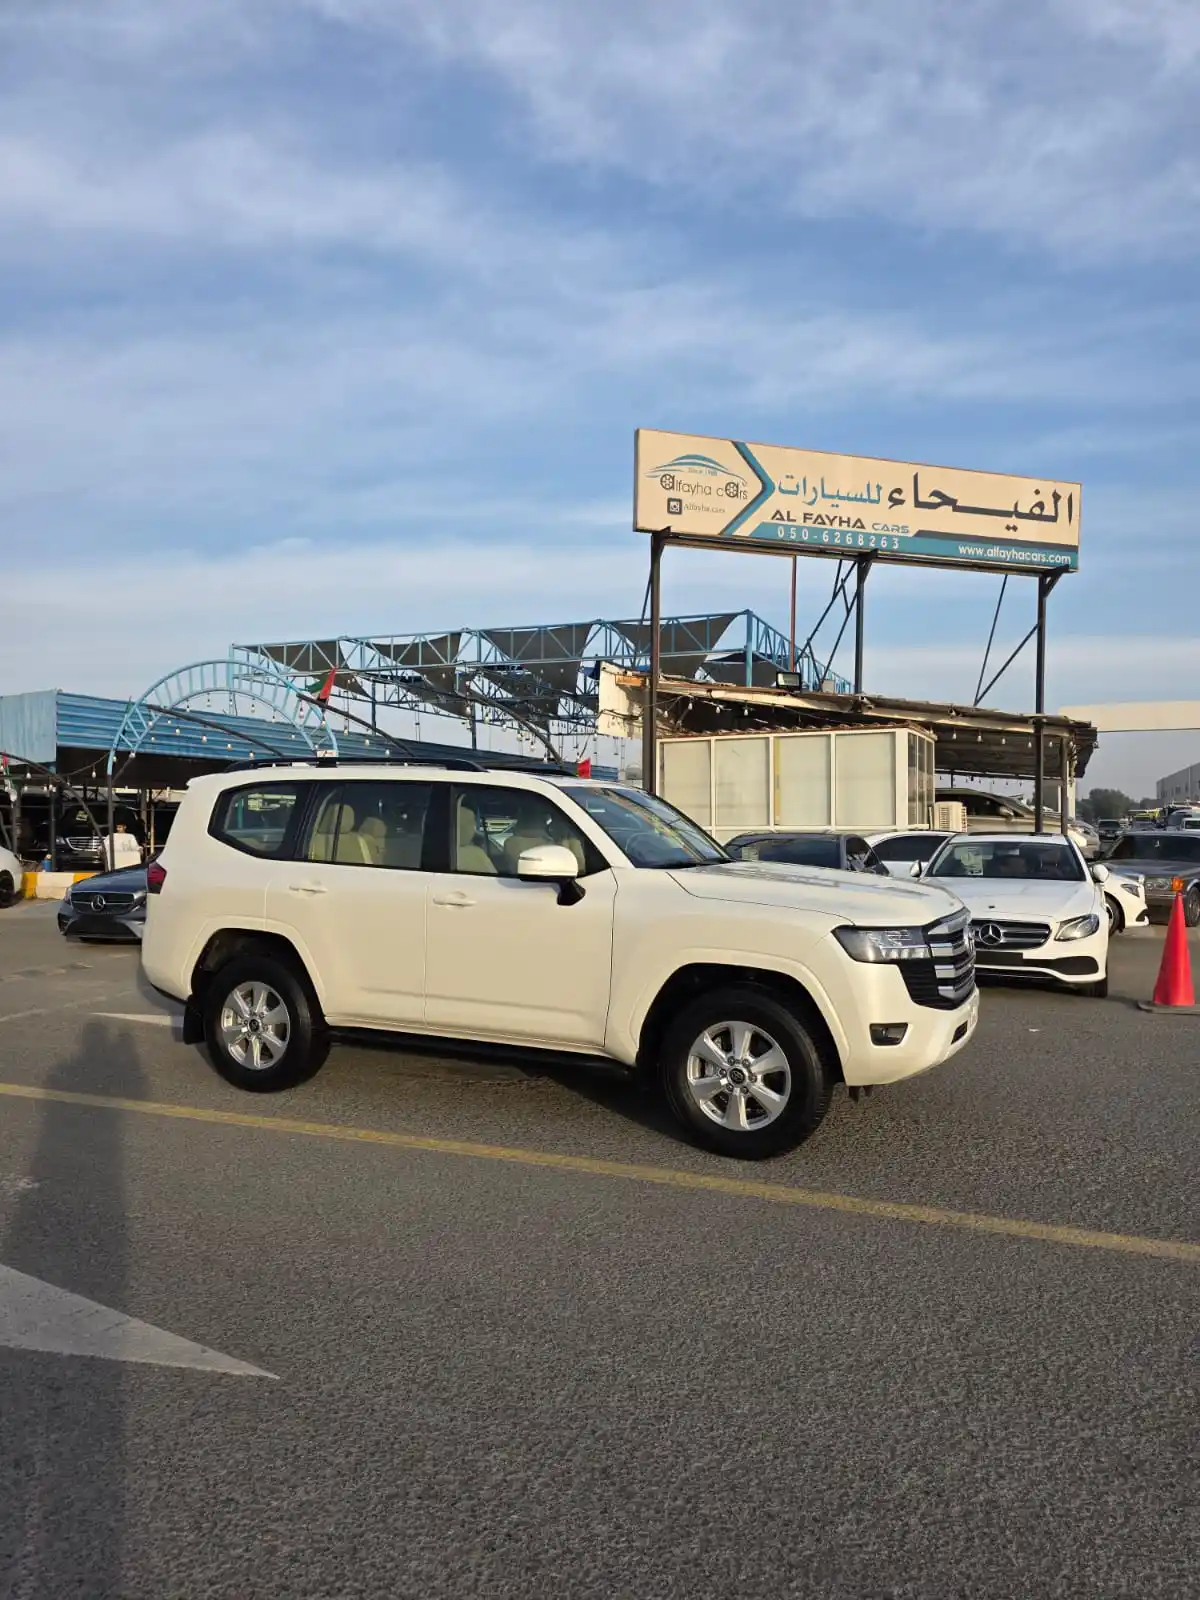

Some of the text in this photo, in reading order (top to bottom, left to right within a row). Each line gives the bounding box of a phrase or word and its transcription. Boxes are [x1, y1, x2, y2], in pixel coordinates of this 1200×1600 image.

[660, 473, 748, 500] alfayha cars
[778, 471, 1073, 532] الفيحاء للسيارات
[771, 509, 909, 534] AL FAYHA CARS
[958, 545, 1071, 565] www.alfayhacars.com
